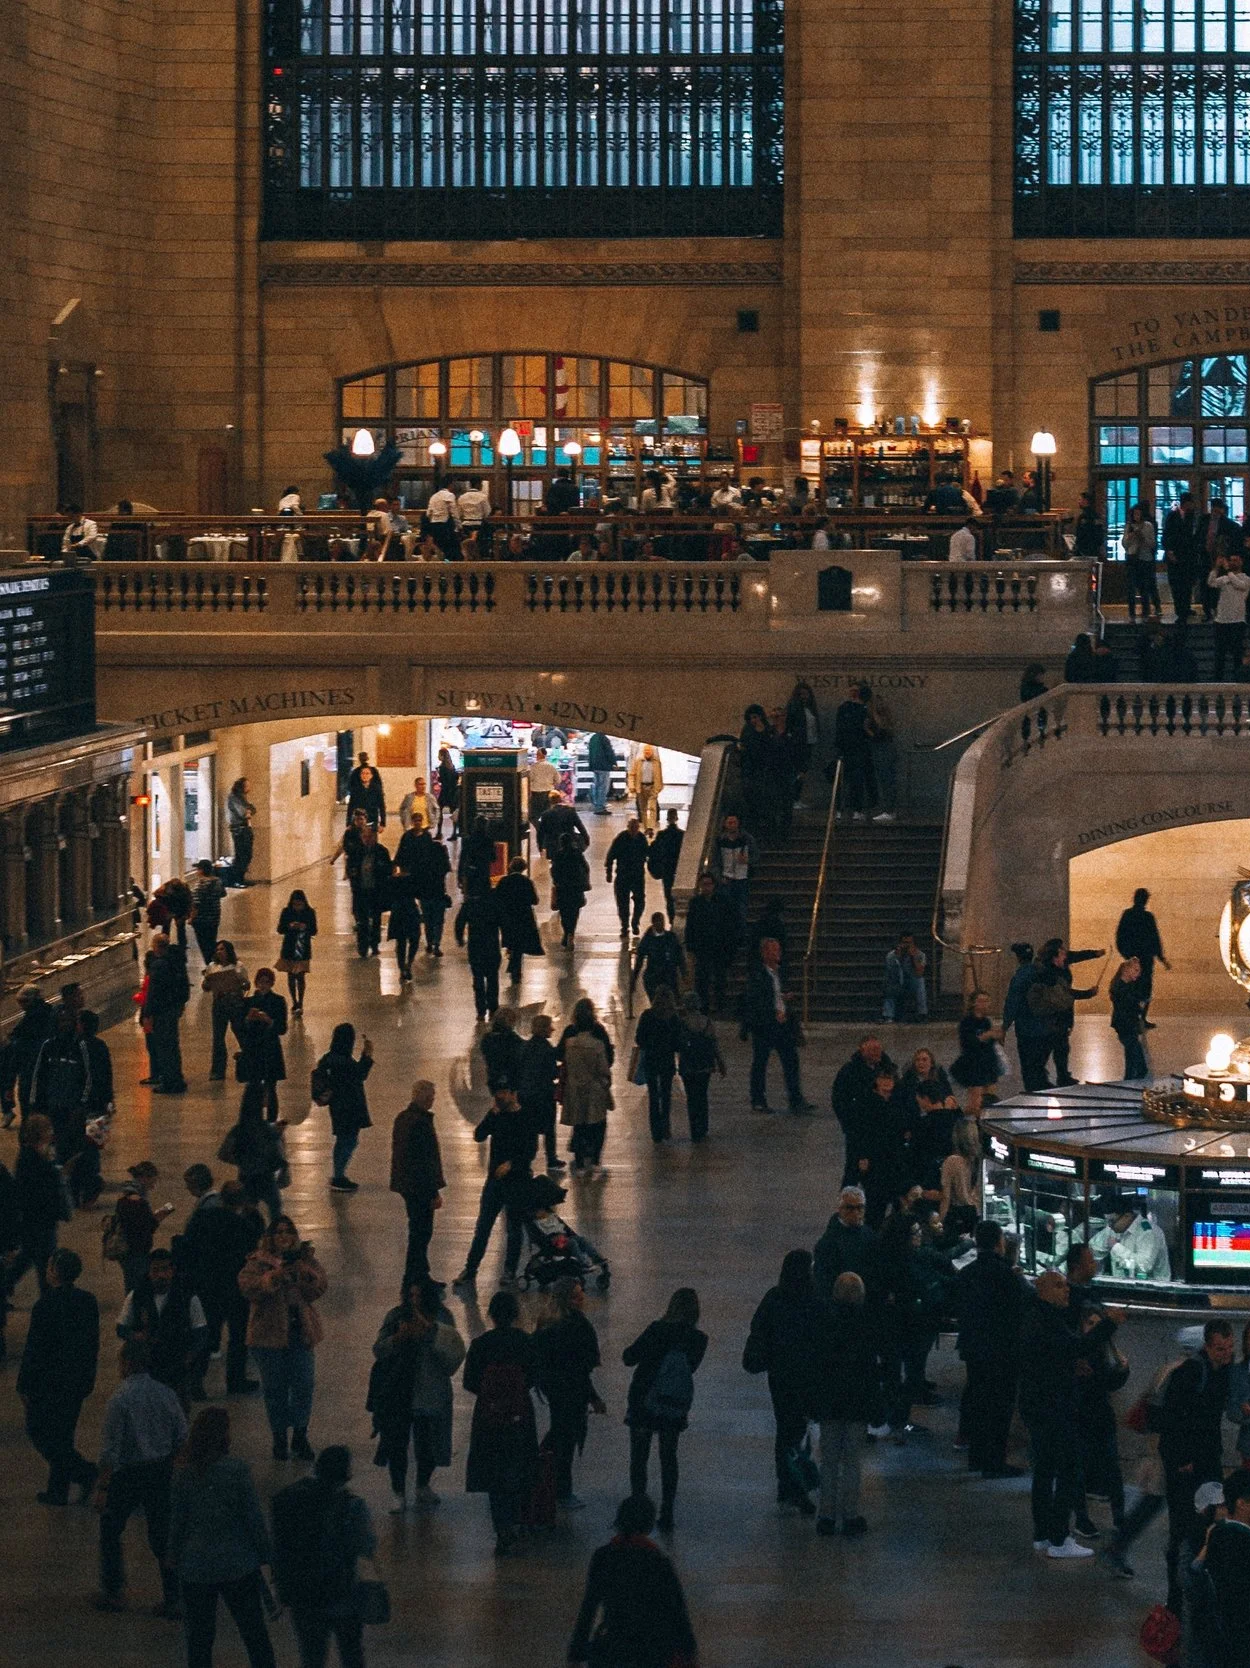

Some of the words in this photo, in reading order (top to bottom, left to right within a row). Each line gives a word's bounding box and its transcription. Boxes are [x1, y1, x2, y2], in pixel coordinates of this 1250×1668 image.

[1129, 318, 1160, 337] TO
[1112, 338, 1161, 360] THE
[135, 702, 223, 730] TICKET
[230, 687, 356, 716] MACHINES
[549, 699, 608, 725] 42ND
[613, 711, 643, 732] ST
[1078, 817, 1138, 845] DINING
[1141, 800, 1235, 826] CONCOURSE
